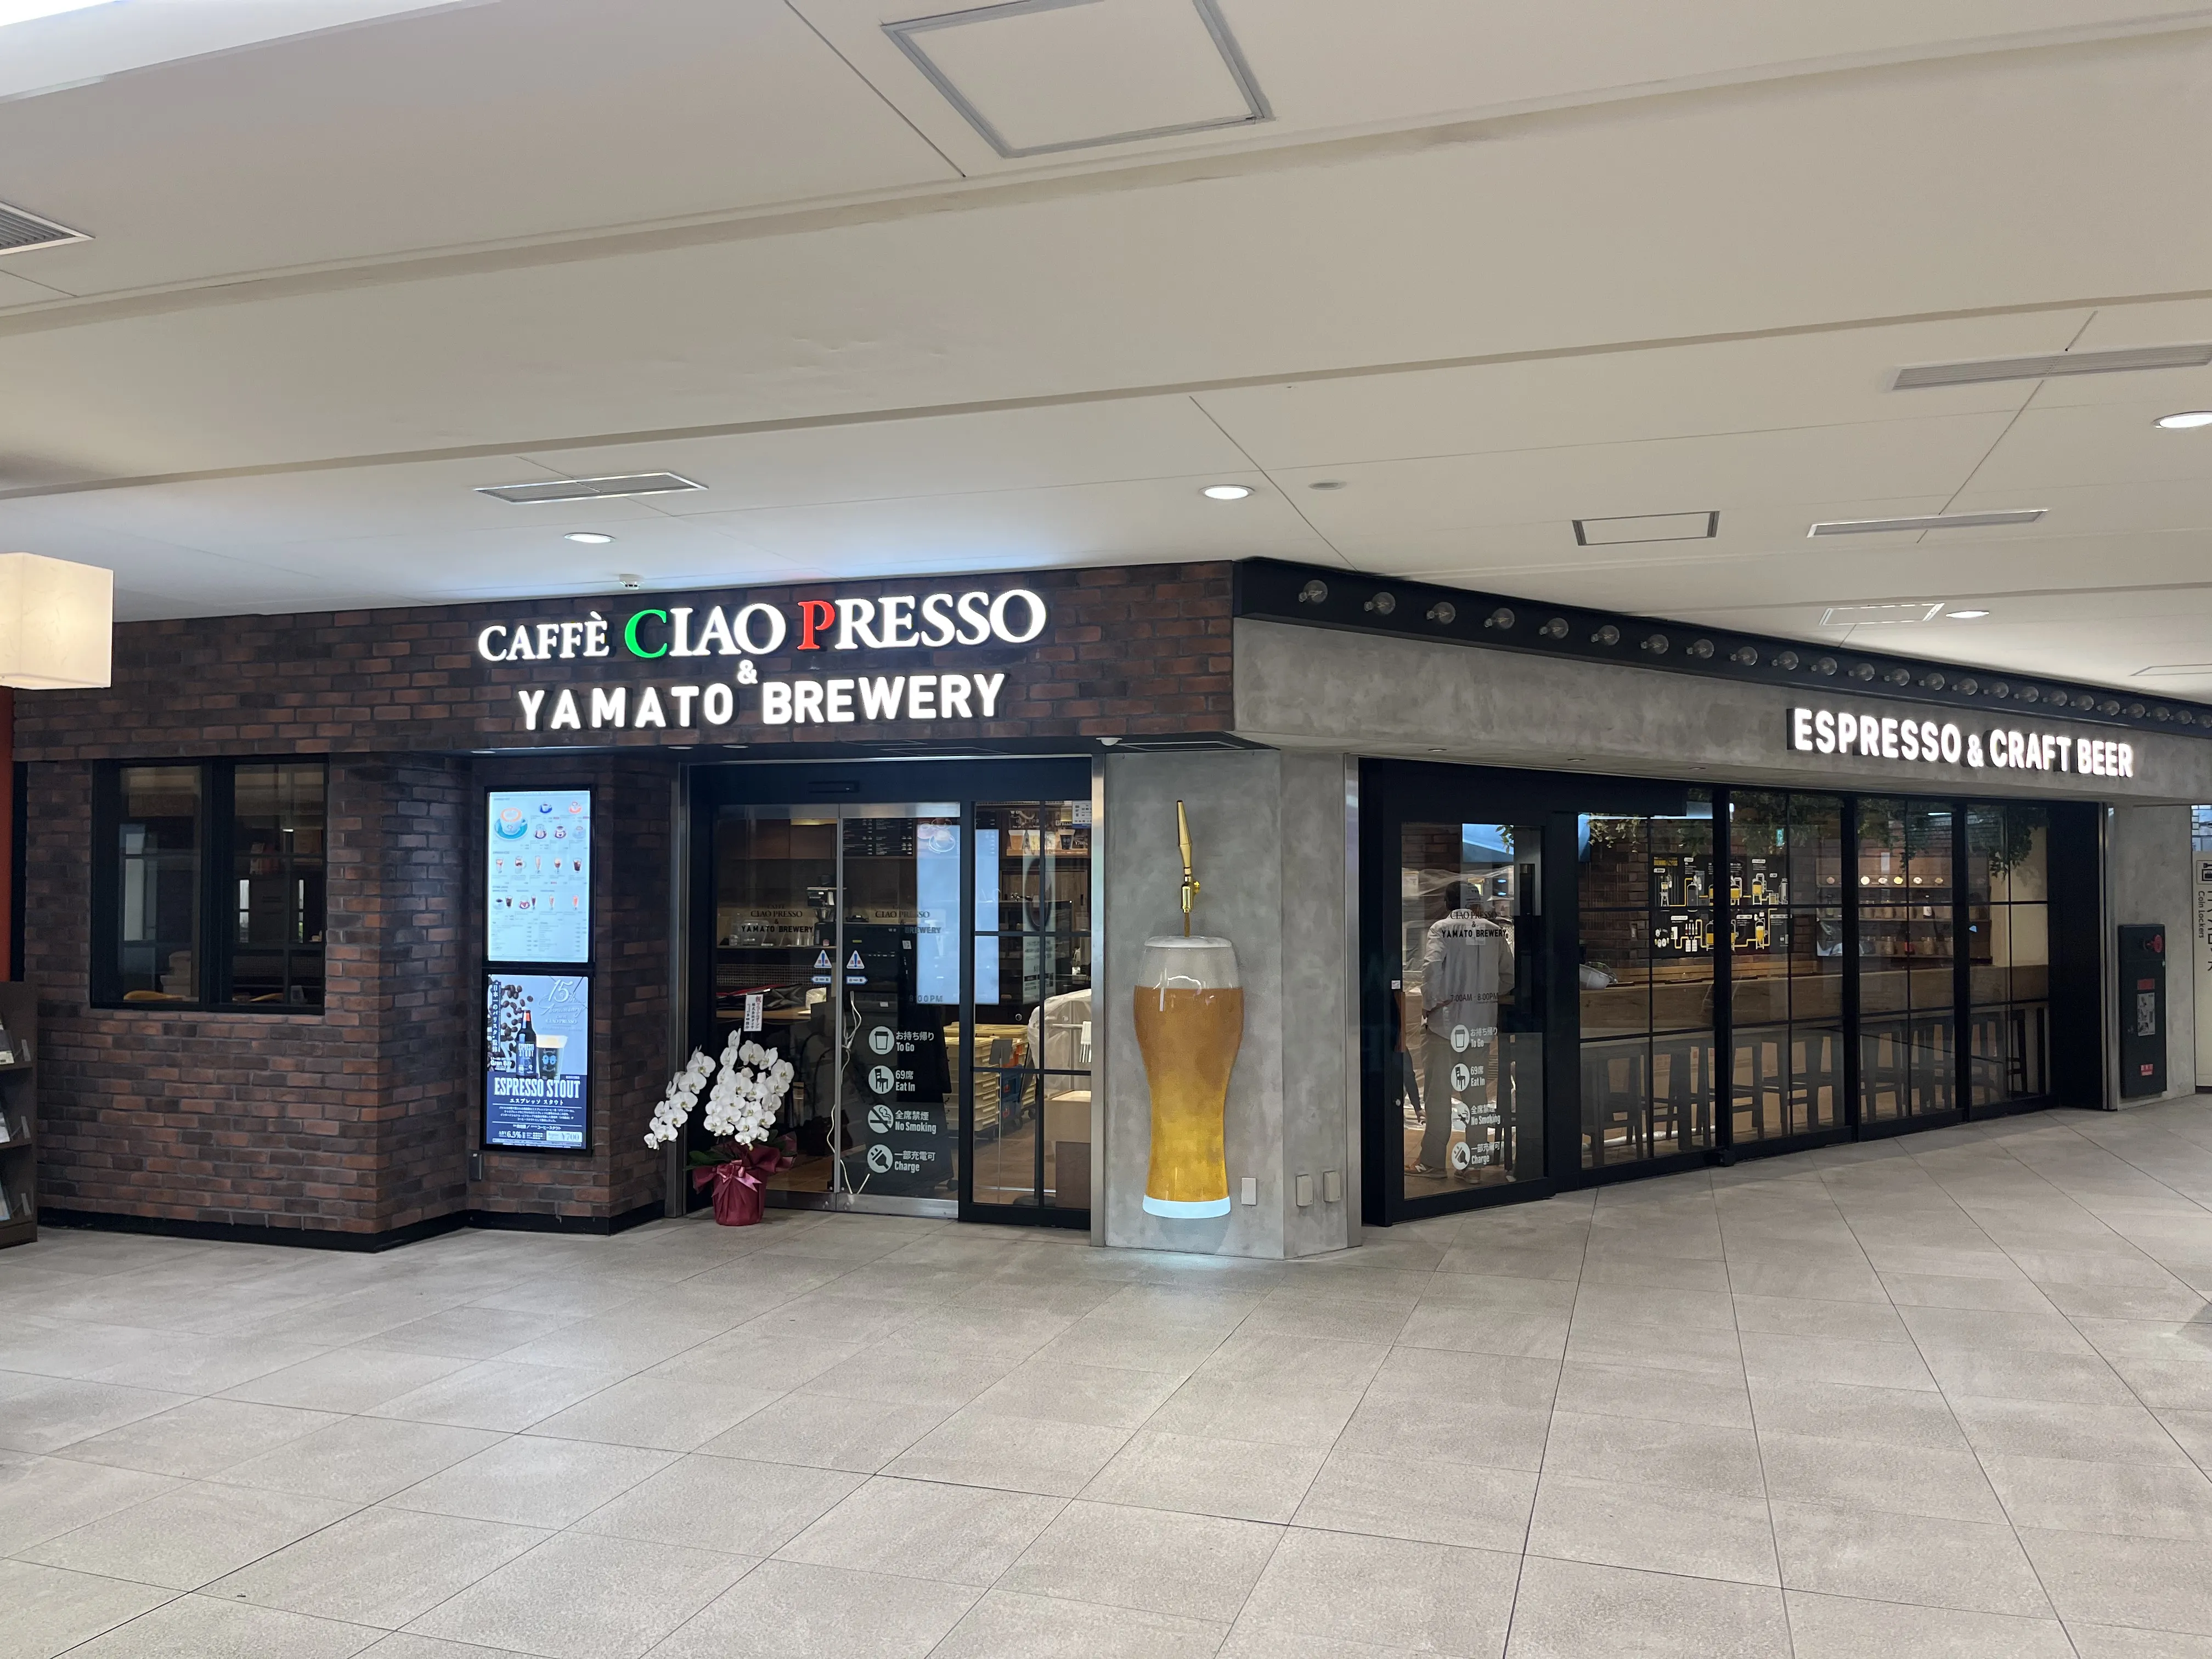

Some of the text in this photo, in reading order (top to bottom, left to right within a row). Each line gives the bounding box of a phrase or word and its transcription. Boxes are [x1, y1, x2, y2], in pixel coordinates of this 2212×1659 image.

[478, 589, 1046, 662] CAFFÈ CIAO PRESSO
[737, 659, 758, 685] &
[518, 673, 1005, 731] YAMATO BREWERY
[1794, 708, 2134, 777] ESPRESSO & CRAFT BEER
[1450, 911, 1470, 919] CIAO
[1442, 929, 1506, 938] YAMATO BREWERY
[1450, 994, 1472, 1002] 7:00AM
[1477, 992, 1499, 1001] 8:00PM
[896, 1031, 934, 1041] お持ち帰り
[1470, 1026, 1498, 1037] お持ち帰り
[896, 1042, 915, 1052] To Go
[1471, 1039, 1484, 1048] To Go
[895, 1070, 914, 1080] 69席
[1470, 1065, 1484, 1075] 69席
[895, 1081, 915, 1092] Eat In
[1471, 1076, 1485, 1087] Eat In
[494, 1077, 581, 1098] ESPRESSO STOUT
[895, 1109, 929, 1121] 全席禁煙
[1471, 1114, 1501, 1126] No Smoking
[895, 1121, 936, 1135] No Smoking
[1471, 1141, 1500, 1153] 一部充可
[894, 1150, 936, 1161] 一部充電可
[1471, 1155, 1490, 1165] Charge
[894, 1161, 920, 1173] Charge
